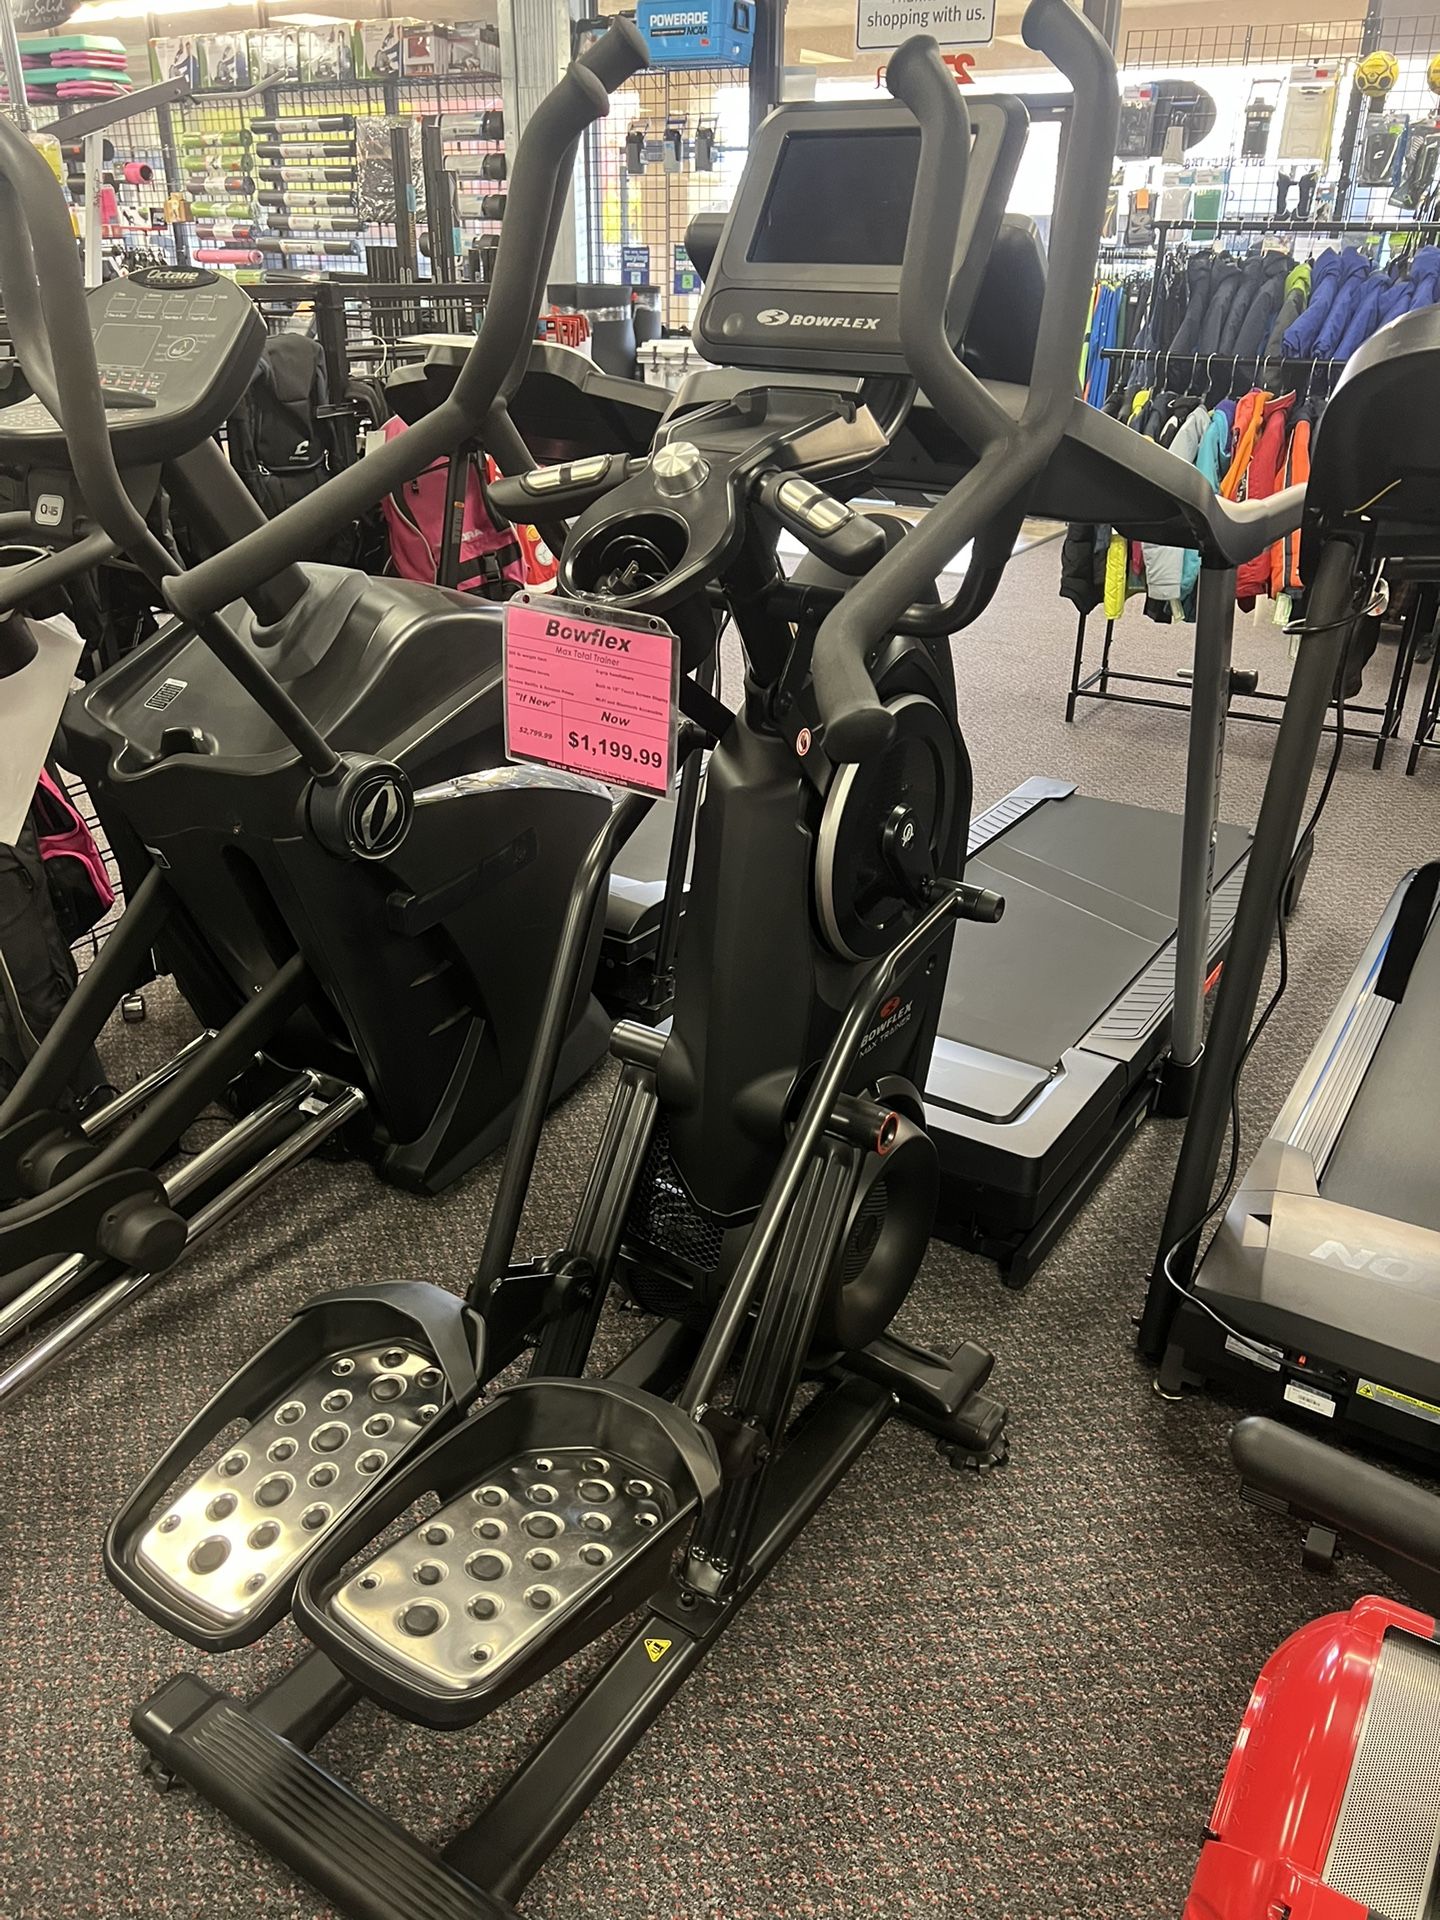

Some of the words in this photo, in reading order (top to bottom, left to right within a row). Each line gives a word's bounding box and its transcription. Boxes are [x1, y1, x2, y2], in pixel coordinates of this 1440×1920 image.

[649, 11, 709, 27] POWERADE
[867, 8, 930, 30] shopping
[932, 5, 961, 23] with
[965, 7, 986, 21] us.
[147, 269, 199, 280] Octane
[789, 314, 881, 330] BOWFLEX
[545, 619, 632, 652] Bowflex
[555, 646, 571, 656] Max
[573, 650, 592, 661] Total
[594, 654, 620, 666] Trainer
[516, 692, 527, 702] "If
[529, 695, 556, 708] New"
[600, 711, 630, 726] Now
[519, 725, 553, 741] $2,799.99
[568, 731, 662, 769] $1,199.99
[860, 1000, 913, 1048] BOWFLEX
[880, 1013, 912, 1042] TRAINER
